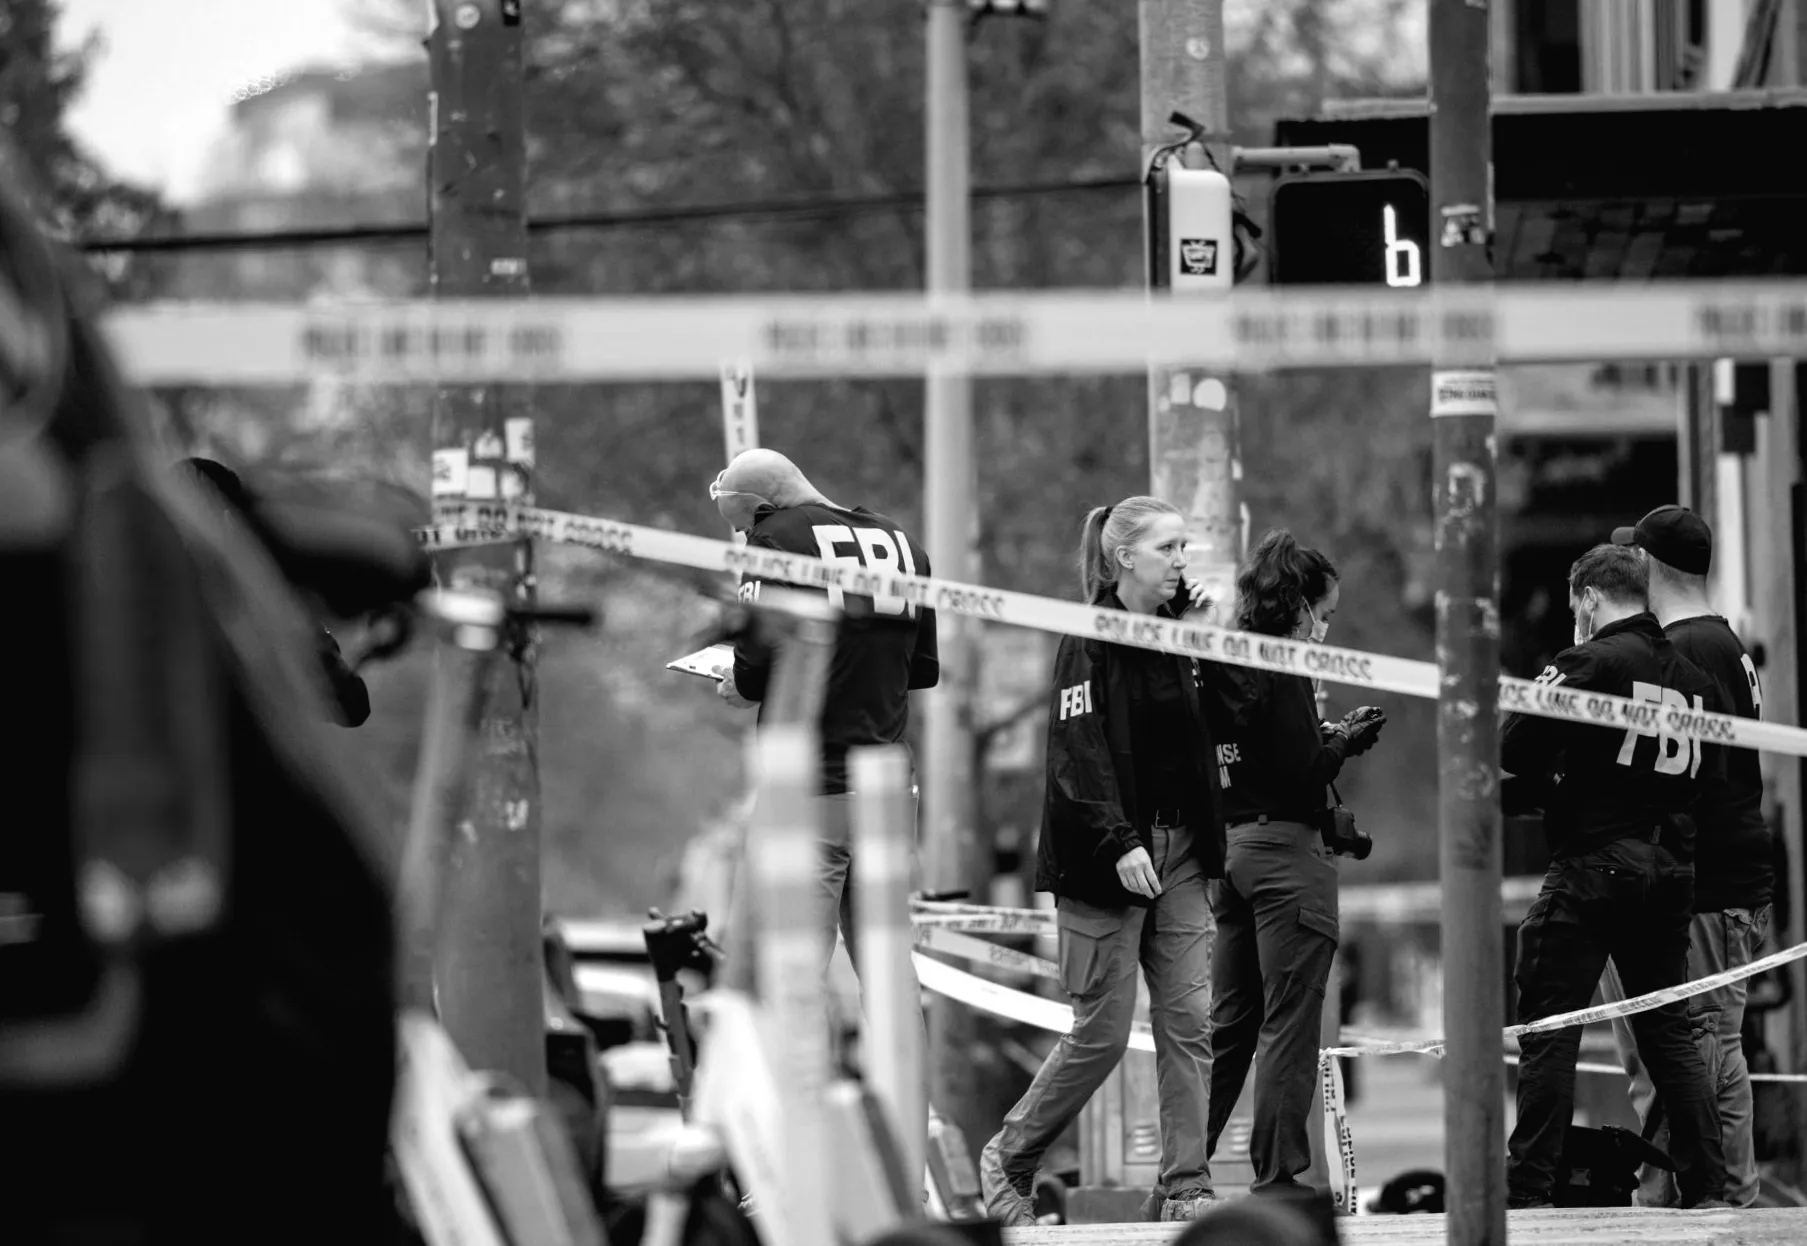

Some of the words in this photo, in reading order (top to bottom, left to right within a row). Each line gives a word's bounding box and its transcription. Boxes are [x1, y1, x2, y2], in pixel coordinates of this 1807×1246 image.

[1094, 614, 1164, 647] POLICE
[1171, 626, 1216, 652] LINE
[1222, 634, 1250, 660] DO
[1258, 642, 1297, 667] NOT
[1303, 649, 1373, 681] CROSS
[1059, 680, 1093, 721] FBI
[1535, 688, 1582, 718] LINE
[1586, 697, 1616, 723] DO
[1620, 703, 1662, 732] NOT
[1666, 709, 1736, 742] CROSS
[1616, 680, 1703, 779] FBI
